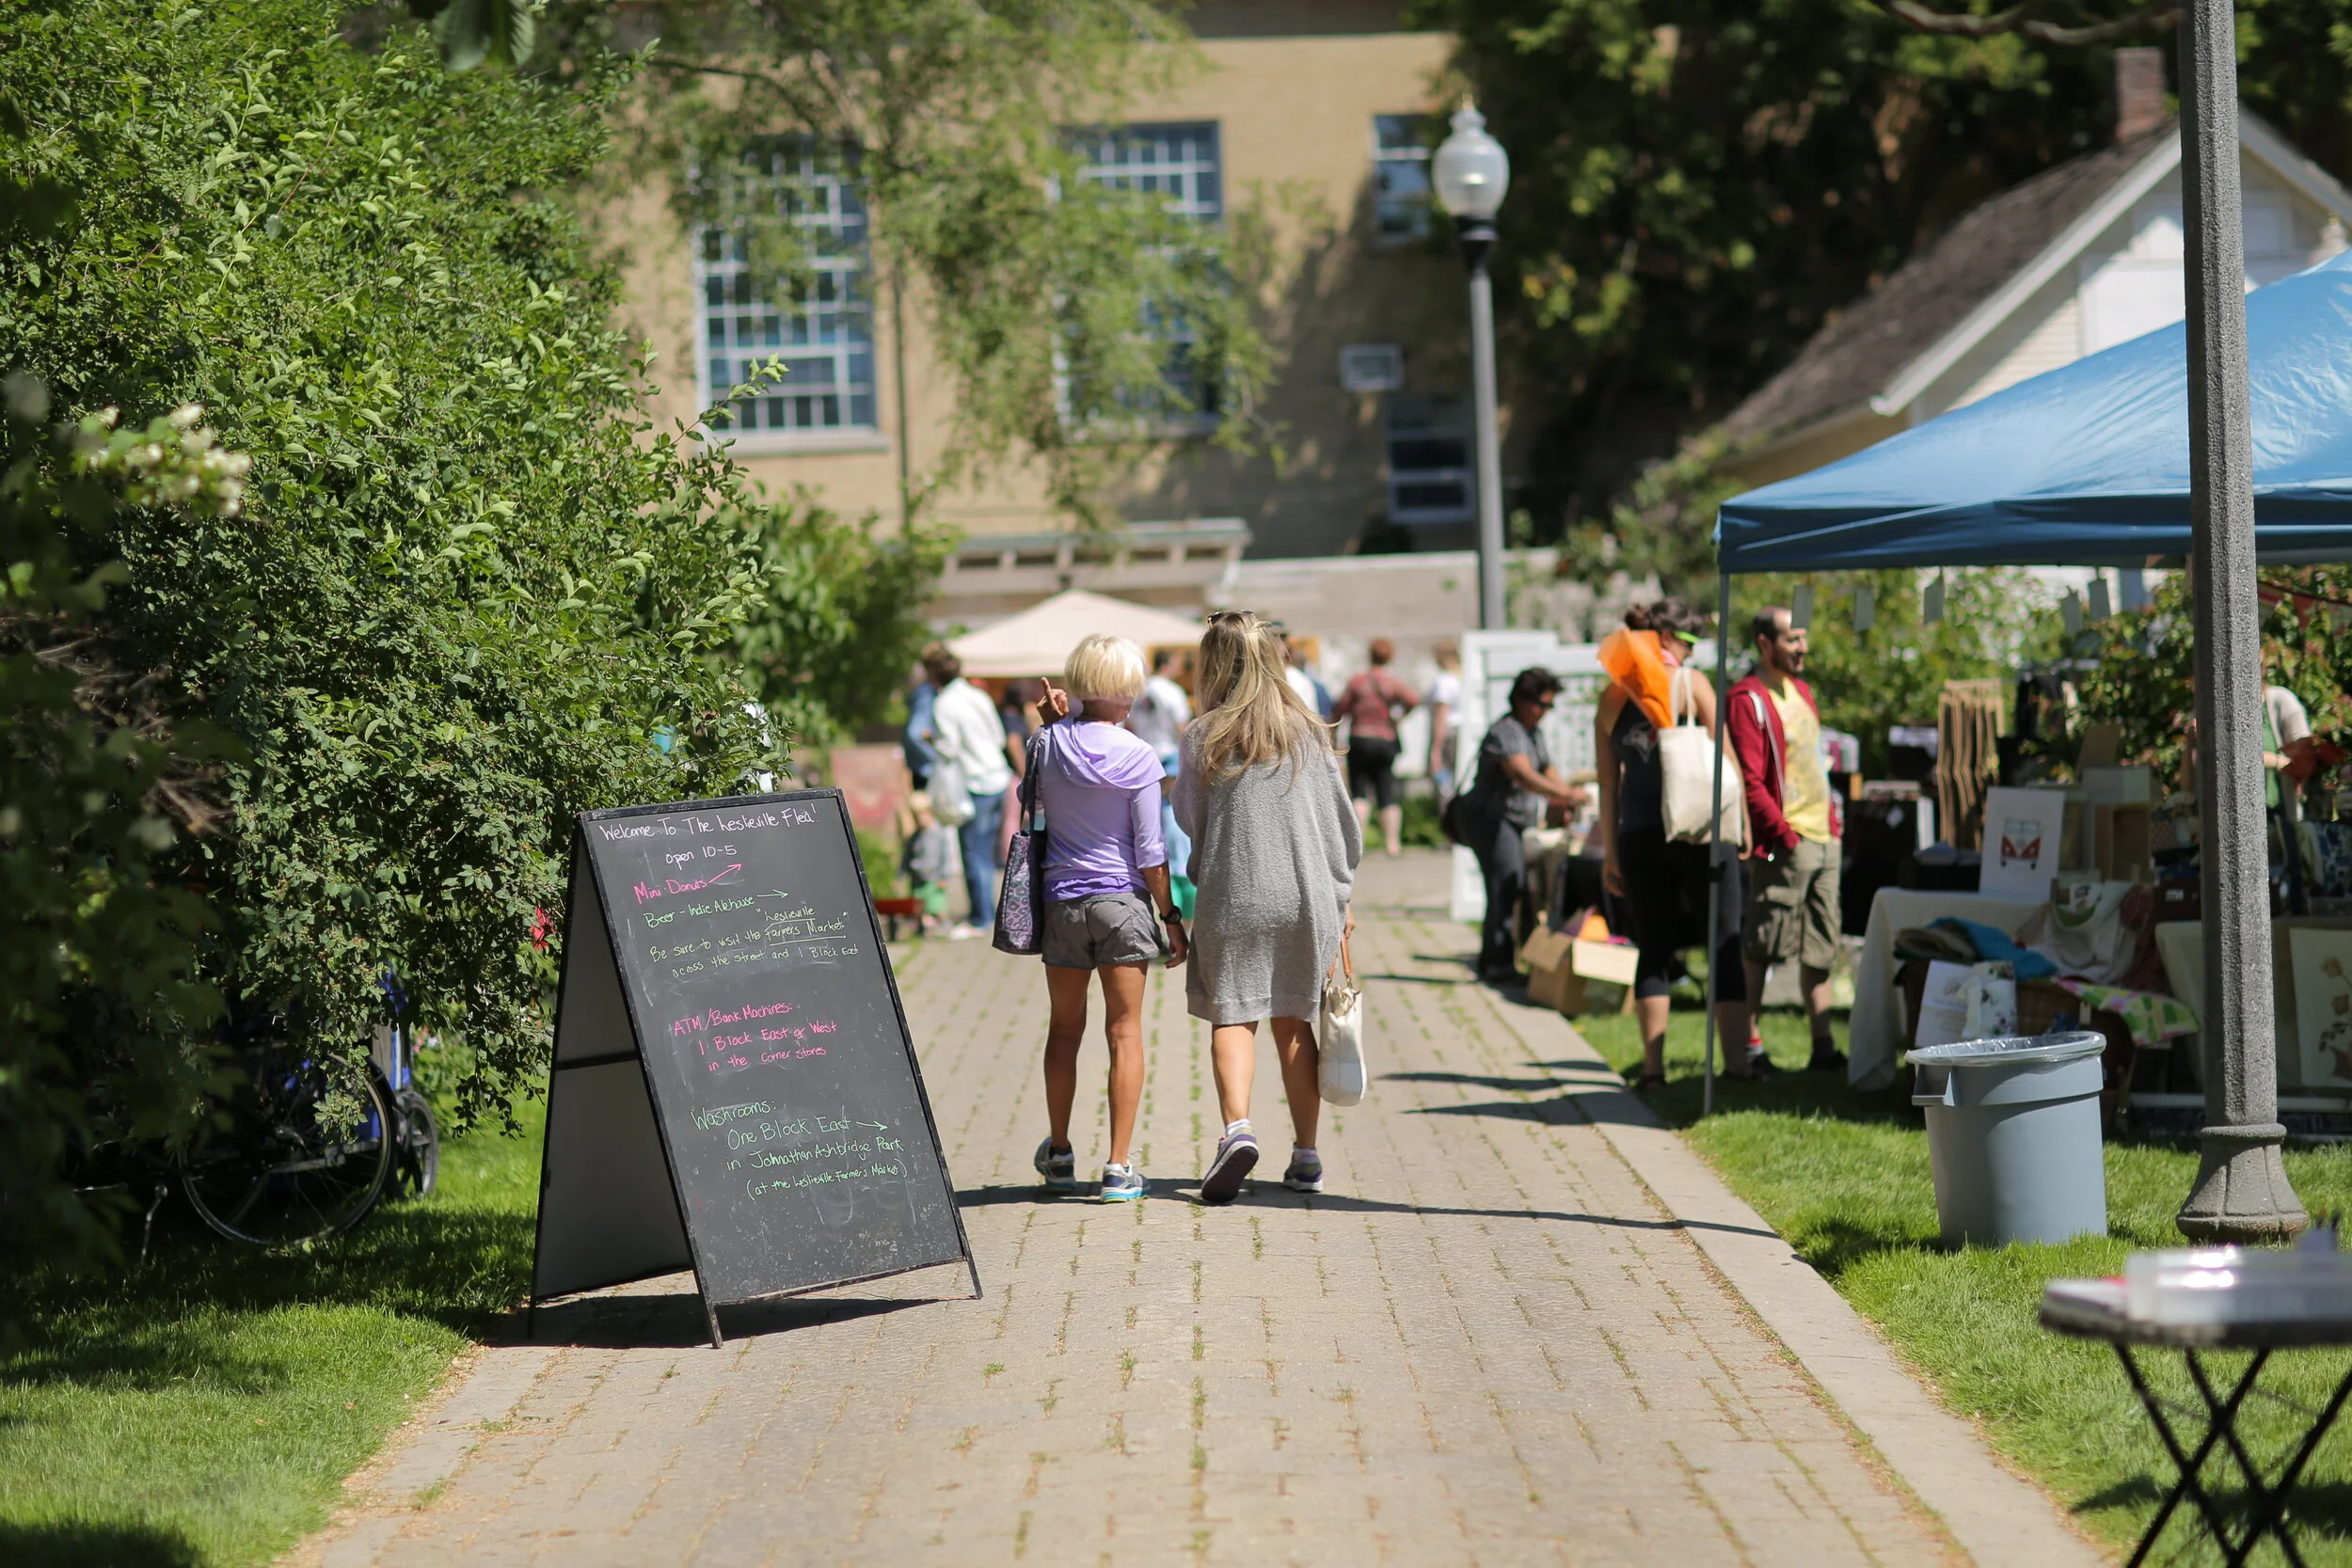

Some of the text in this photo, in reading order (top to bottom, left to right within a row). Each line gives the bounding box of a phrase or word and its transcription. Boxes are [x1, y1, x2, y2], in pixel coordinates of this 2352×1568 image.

[598, 803, 819, 841] Welcome To The Leslieville Flea!
[703, 845, 738, 858] 10-5
[665, 879, 707, 895] Donuts
[643, 911, 675, 928] Beer
[688, 903, 713, 916] Indie
[714, 895, 755, 912] Alehouse
[650, 945, 667, 963] Be
[673, 943, 695, 957] sure
[699, 937, 711, 950] to
[718, 933, 740, 947] visit
[744, 929, 761, 943] the
[672, 960, 705, 978] across
[710, 956, 730, 968] the
[733, 949, 766, 963] street
[771, 947, 790, 959] and
[809, 946, 839, 958] Block
[840, 942, 859, 956] East
[712, 1033, 754, 1052] Block
[760, 1027, 790, 1041] East
[793, 1026, 806, 1040] or
[808, 1020, 838, 1034] West
[707, 1059, 720, 1072] in
[727, 1053, 749, 1068] the
[795, 1045, 827, 1060] stores
[691, 1100, 777, 1131] Washrooms:
[727, 1115, 851, 1150] One Block East
[724, 1136, 904, 1171] in Johnathan Ashbridge Park
[771, 1179, 791, 1191] the
[792, 1171, 835, 1187] Leslieville
